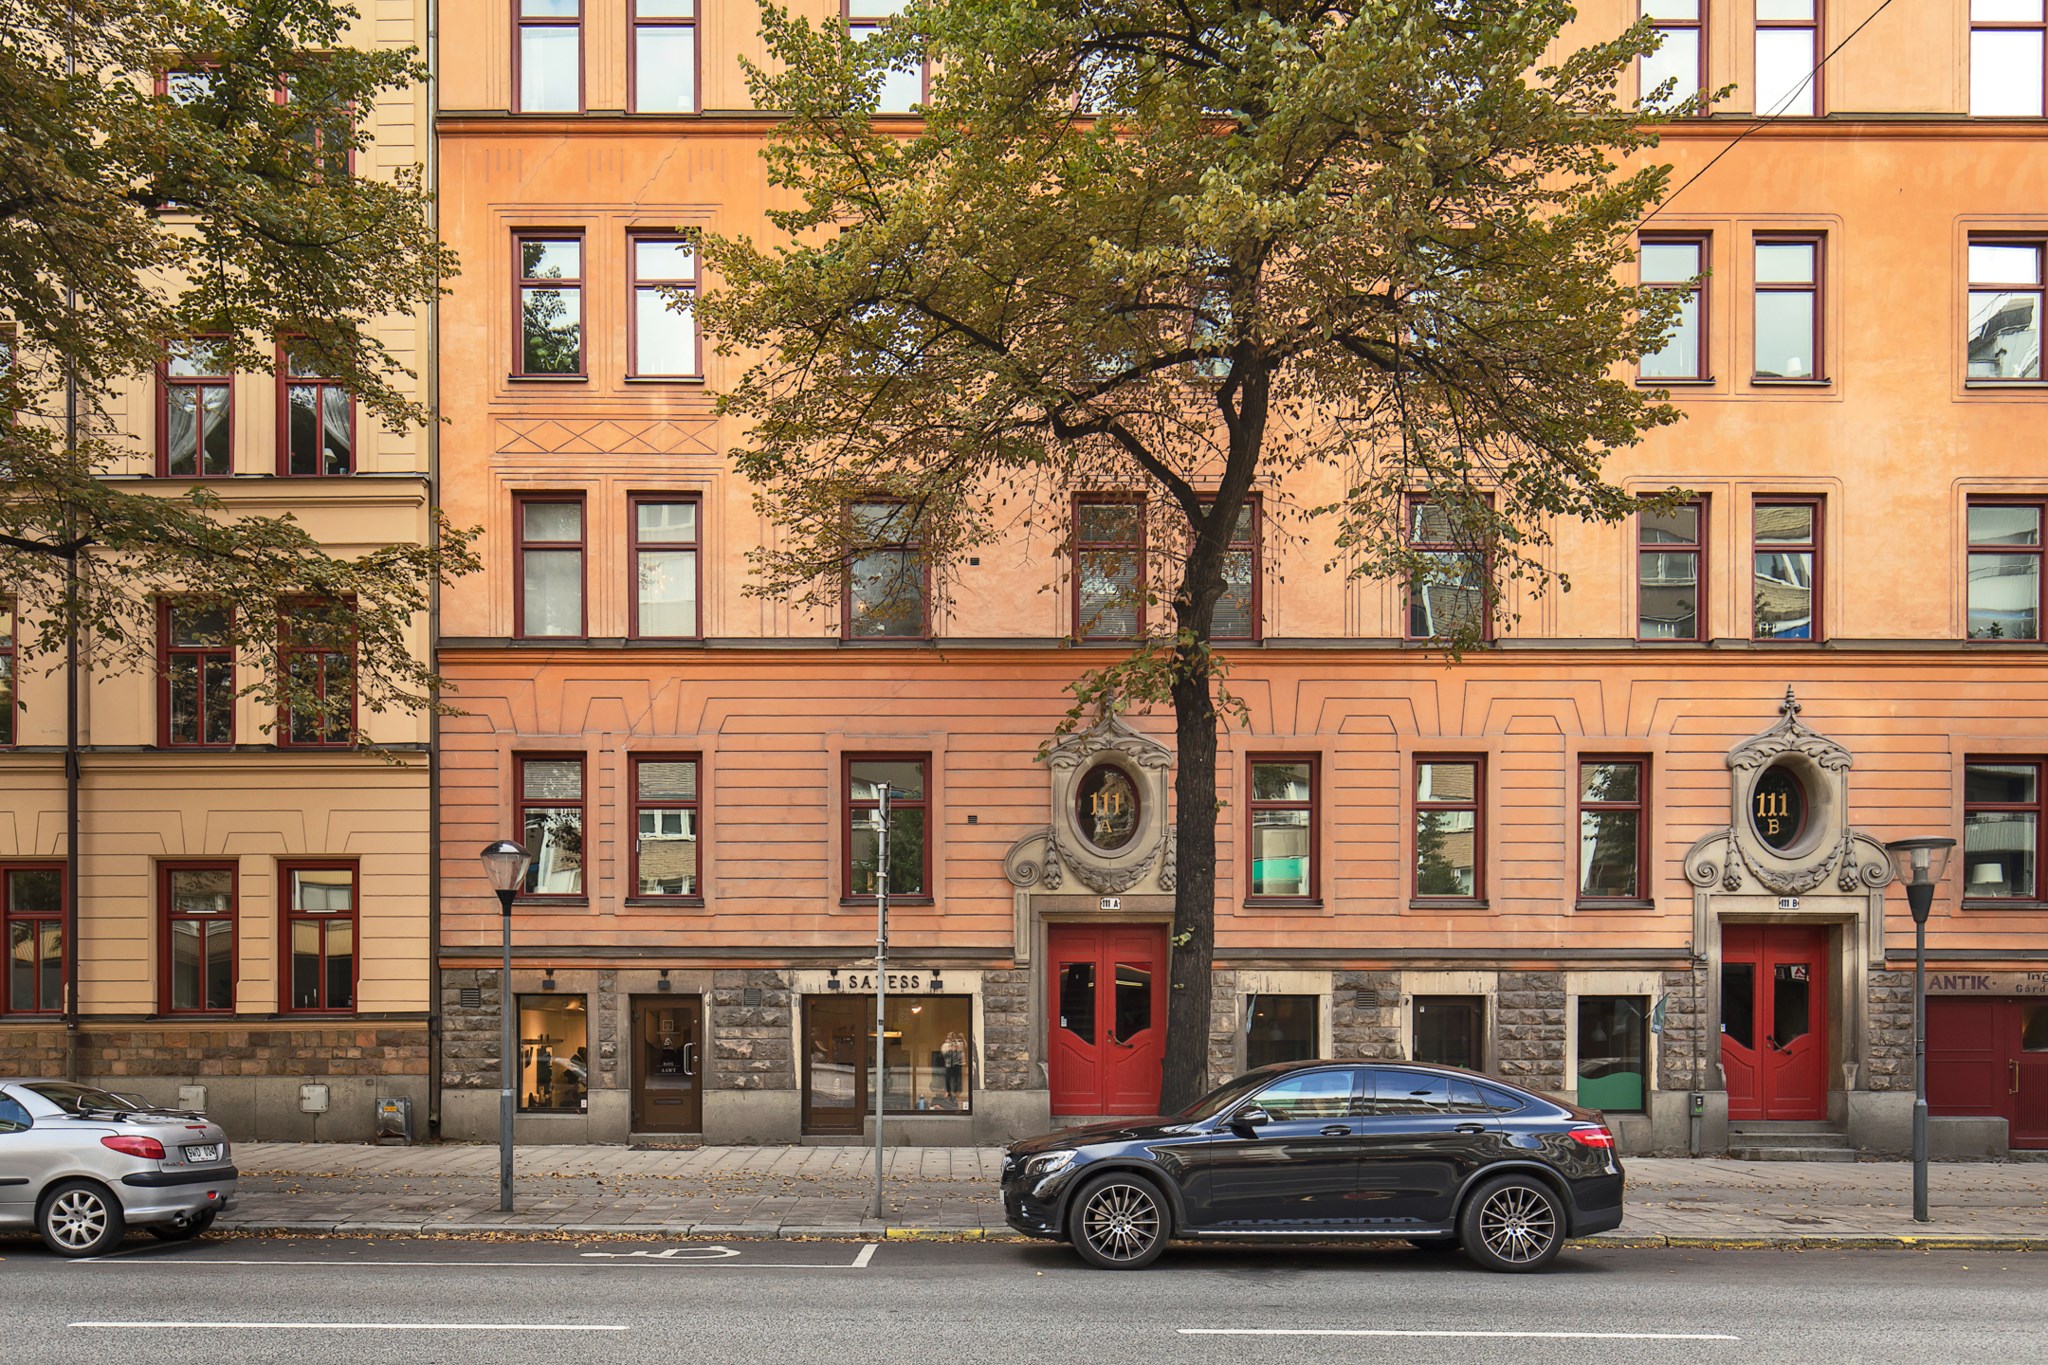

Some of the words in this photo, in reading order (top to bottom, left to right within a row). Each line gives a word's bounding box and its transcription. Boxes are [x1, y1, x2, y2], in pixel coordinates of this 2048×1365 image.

[1090, 792, 1121, 815] 111
[1756, 793, 1788, 817] 111
[1101, 820, 1112, 832] A
[1768, 819, 1780, 835] B
[1781, 899, 1790, 907] 111
[1792, 899, 1798, 907] B
[849, 975, 920, 989] SAESS
[1928, 975, 1990, 990] ANTIK
[2015, 984, 2048, 993] Gård
